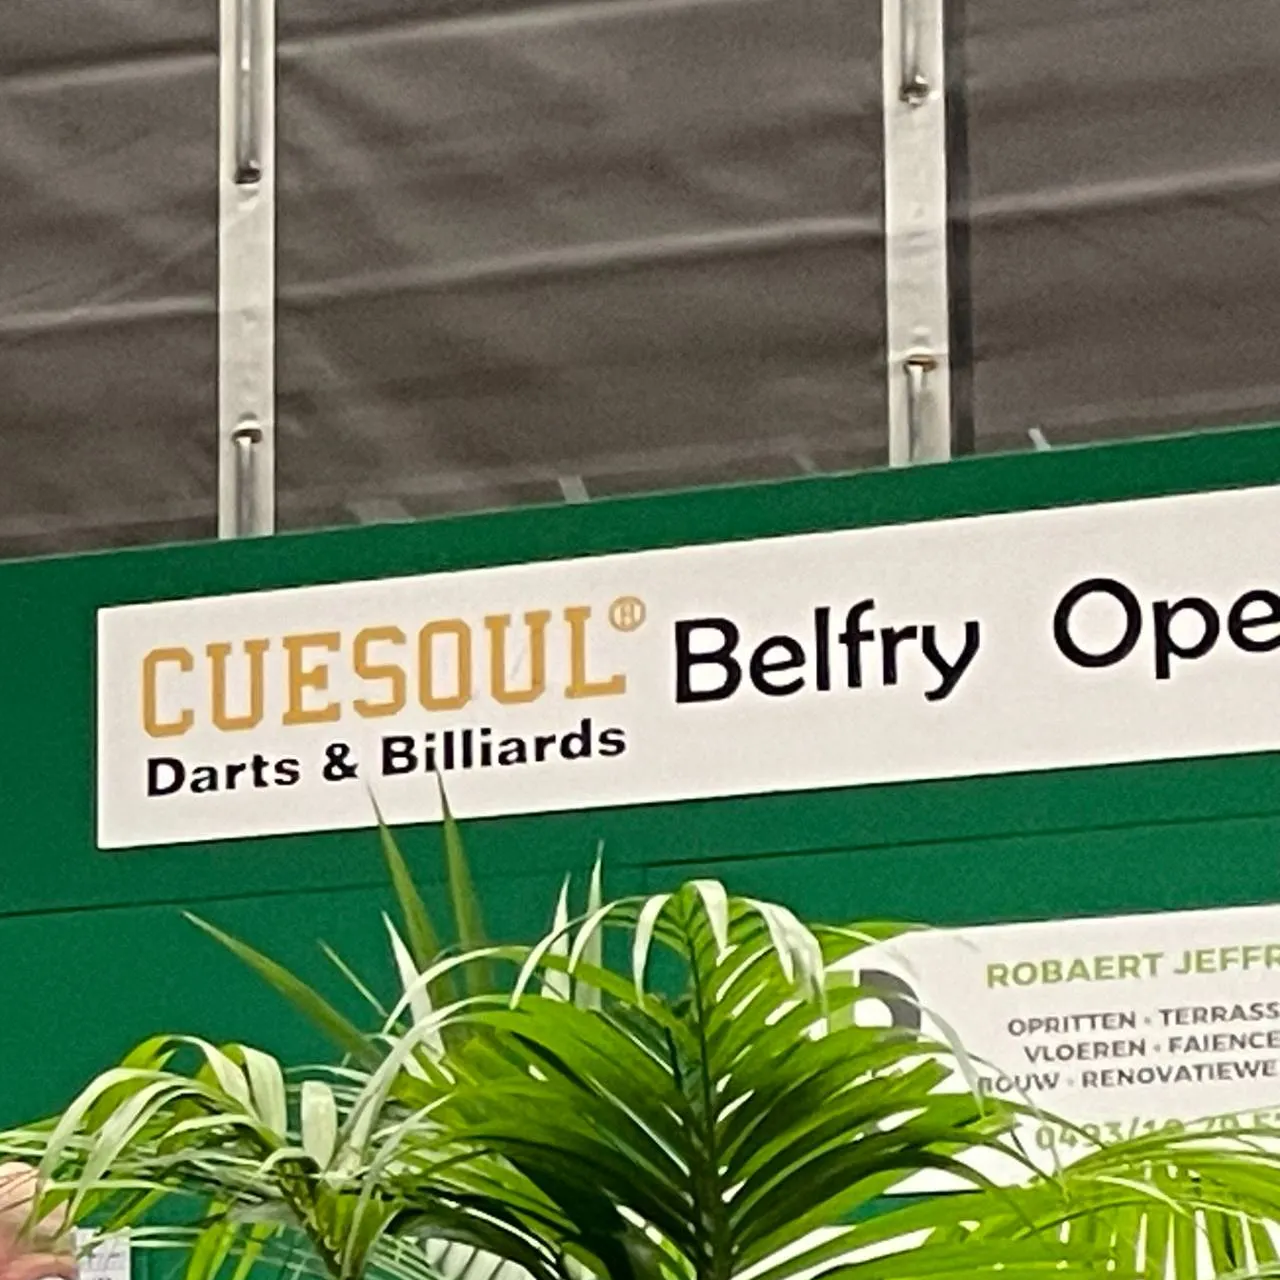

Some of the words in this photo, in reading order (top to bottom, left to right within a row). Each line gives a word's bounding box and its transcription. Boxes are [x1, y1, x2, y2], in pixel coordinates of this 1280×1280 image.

[675, 597, 981, 704] Belfry
[146, 753, 302, 798] Darts
[322, 742, 360, 782] &
[381, 717, 628, 777] Billiards
[986, 950, 1165, 990] ROBAERT
[1007, 1009, 1138, 1037] OPRITTEN
[1023, 1038, 1146, 1064] VLOEREN
[1168, 1029, 1280, 1053] FAIENCE
[1081, 1059, 1279, 1089] RENOVATIEWE
